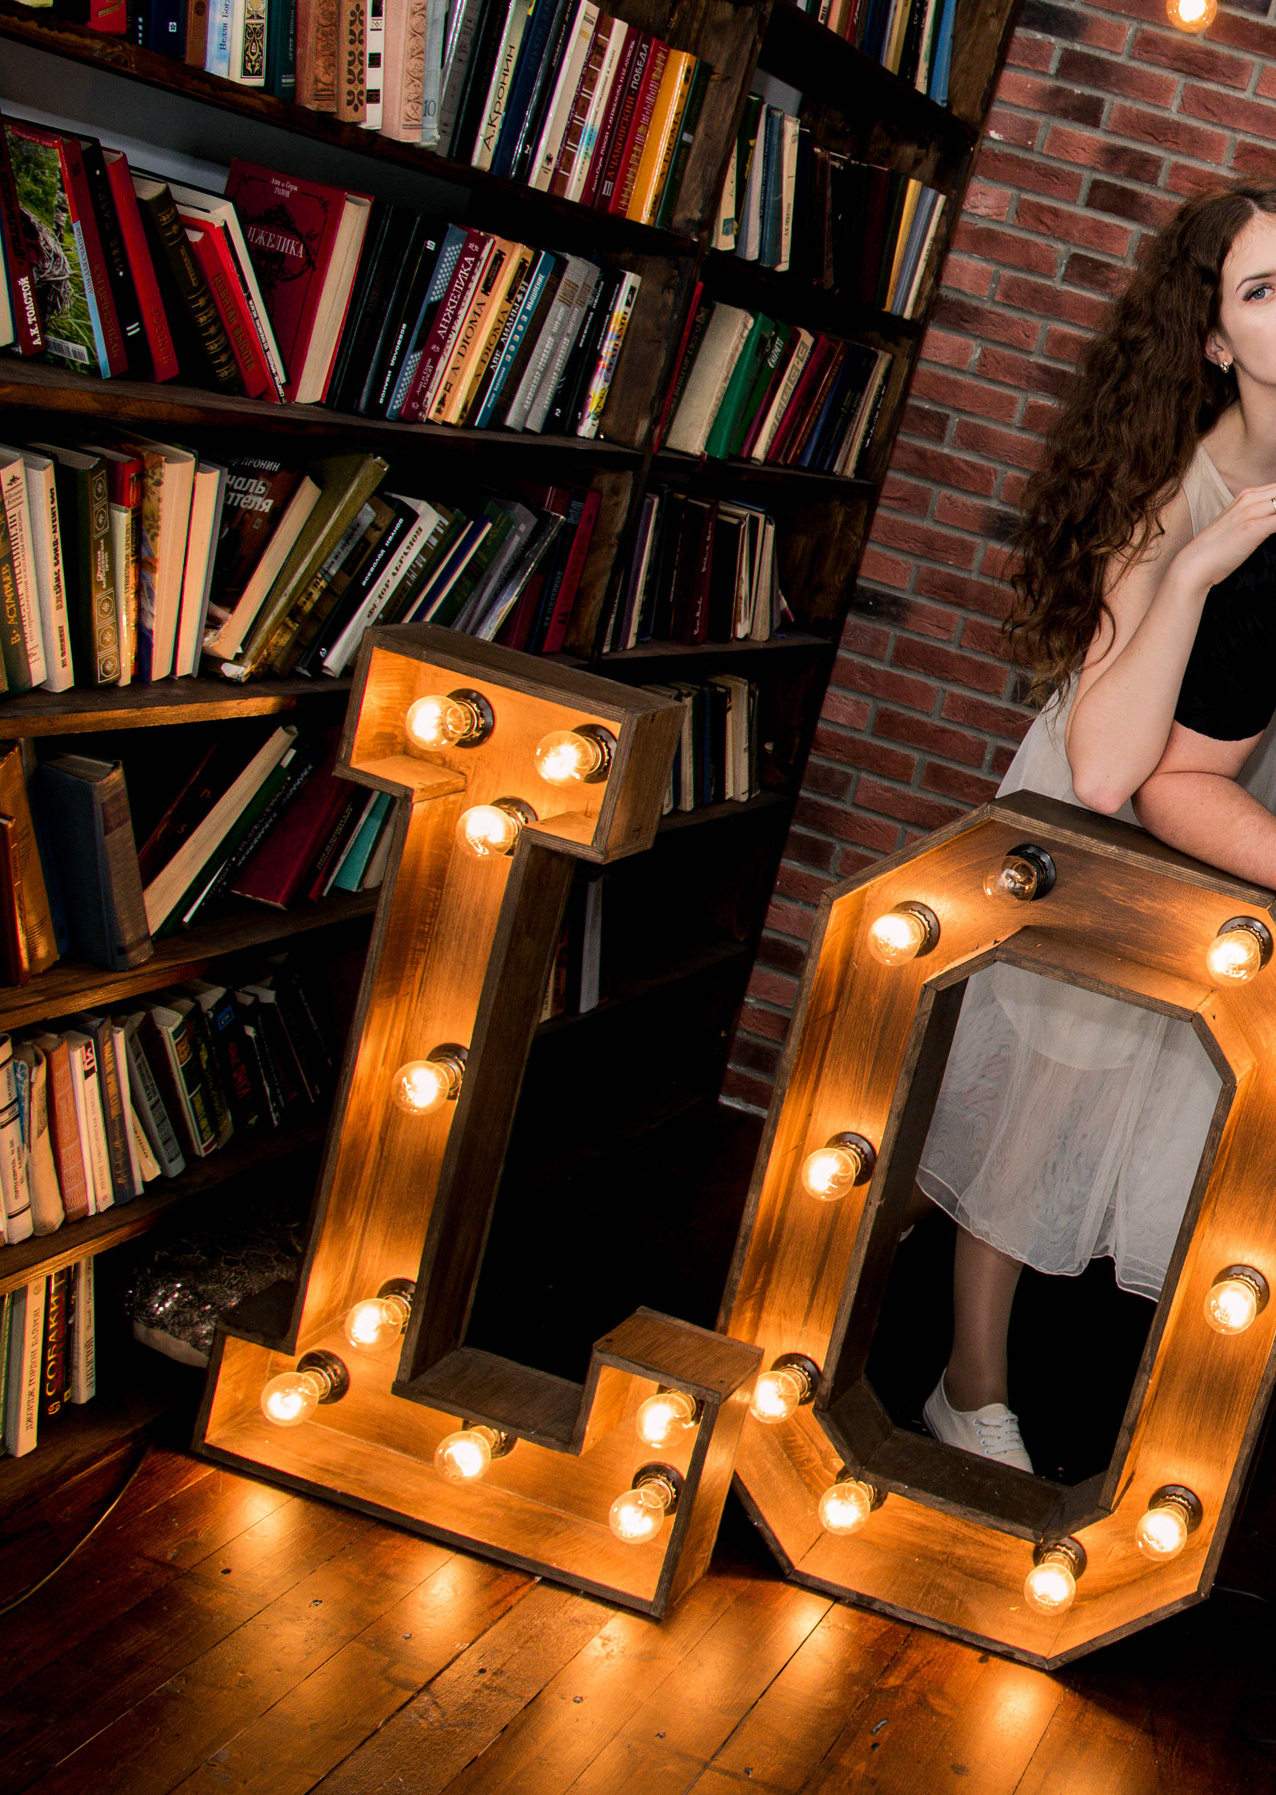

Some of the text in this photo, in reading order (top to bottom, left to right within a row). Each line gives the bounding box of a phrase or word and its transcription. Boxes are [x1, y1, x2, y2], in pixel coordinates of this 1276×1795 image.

[423, 100, 436, 117] 10
[609, 95, 635, 170] ЧАКОВСКИЙ
[631, 43, 649, 91] ПОБЕДА
[247, 226, 304, 259] НЖЕЛИКА
[437, 256, 475, 340] АНЖЕЛИКА
[526, 273, 545, 311] МЫШЛЕНИЕ
[233, 327, 257, 370] ВЫСОТА
[458, 301, 486, 359] ДЮМА
[482, 310, 508, 366] ДЮМА
[490, 350, 502, 373] ДВЕ
[226, 469, 268, 495] чаль
[241, 456, 281, 472] ПРОНИН
[362, 518, 404, 586] ВСЕВОЛОД ИВАНОВ
[1, 563, 20, 626] АСТАФЬЕВ
[52, 569, 63, 610] ДЖЕЙМС
[58, 625, 66, 656] ФЛЕМИНГ
[46, 1295, 60, 1397] СОБАКИ
[26, 1307, 41, 1432] ДЖОРДЖ ГОРДОН БАЙРОН
